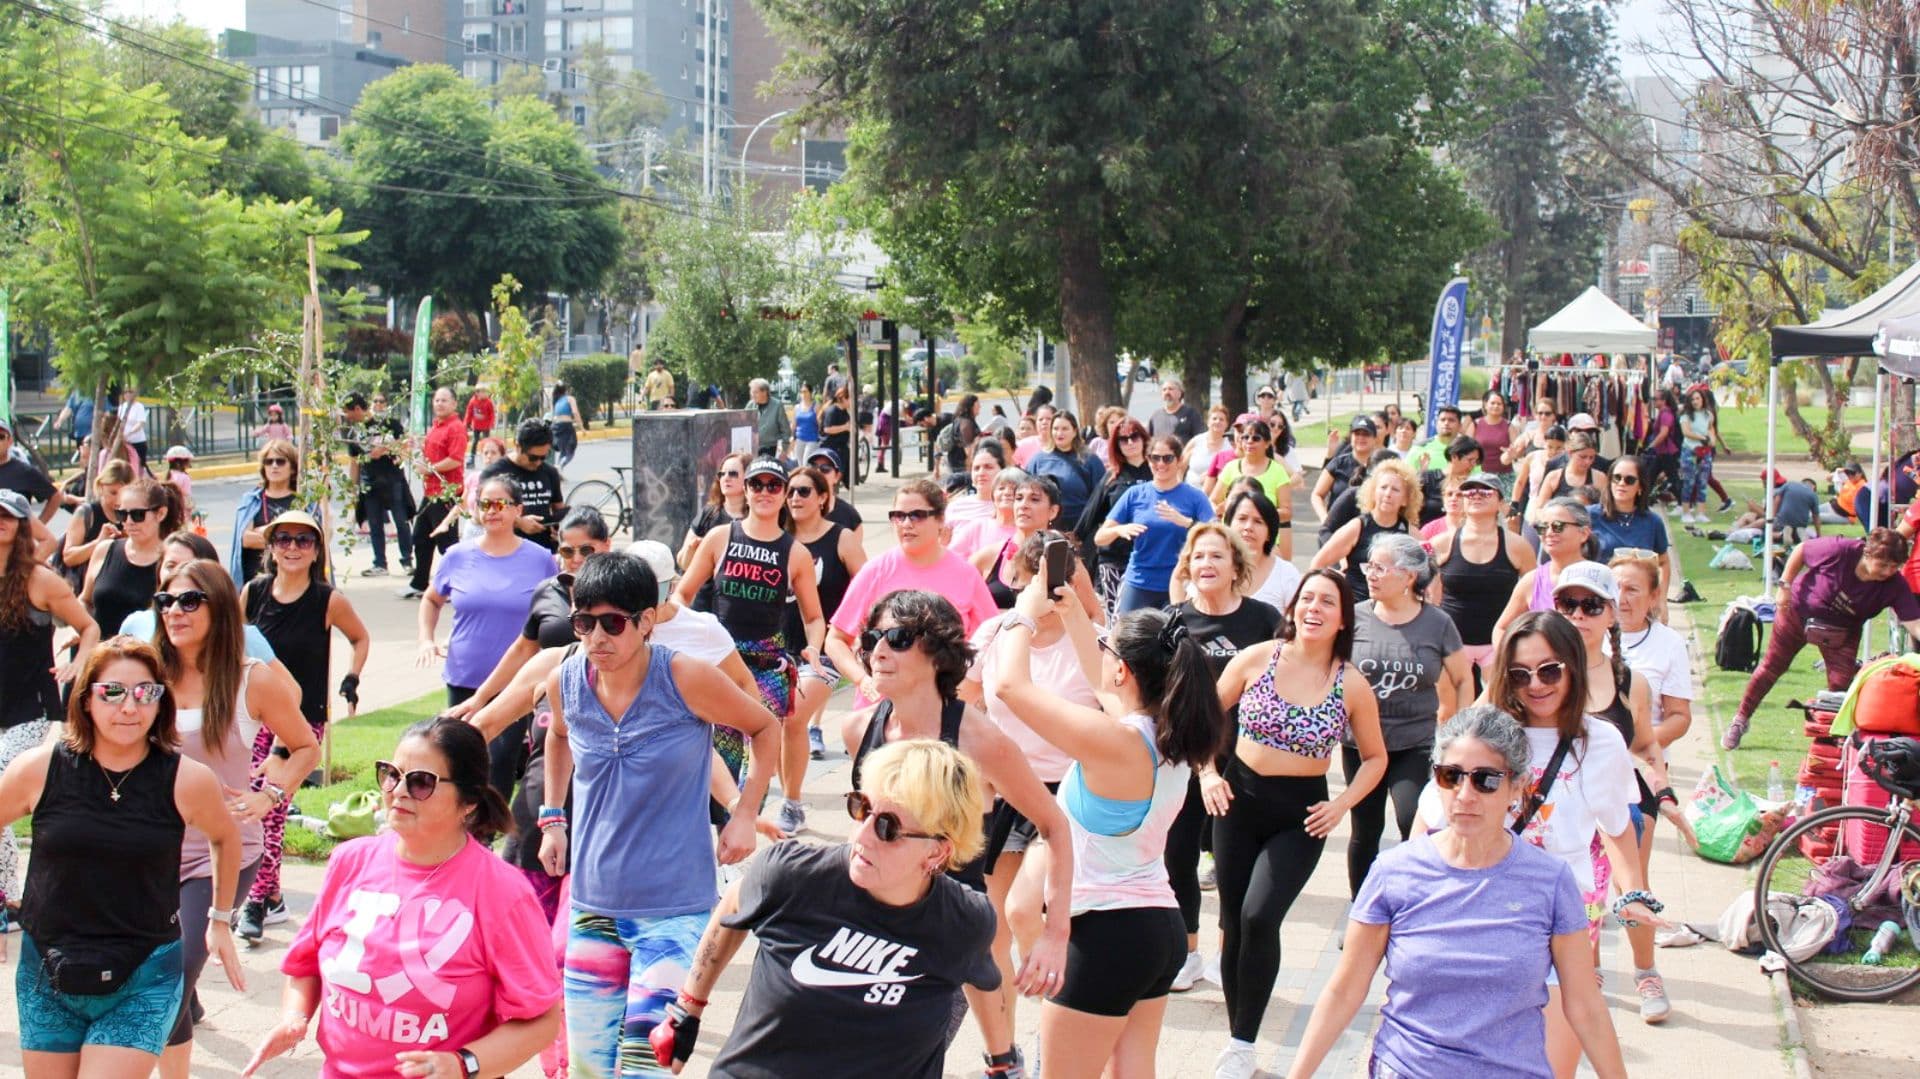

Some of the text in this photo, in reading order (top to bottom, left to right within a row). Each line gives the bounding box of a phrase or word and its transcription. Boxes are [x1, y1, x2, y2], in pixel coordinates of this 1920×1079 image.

[750, 460, 784, 473] ZUMBA
[728, 542, 780, 565] ZUMBA
[724, 561, 762, 581] LOVE
[721, 580, 778, 602] LEAGUE
[1382, 660, 1424, 675] YOUR
[320, 889, 401, 995] I
[817, 927, 918, 977] NIKE
[864, 982, 906, 1006] SB
[326, 988, 449, 1044] ZUMBA
